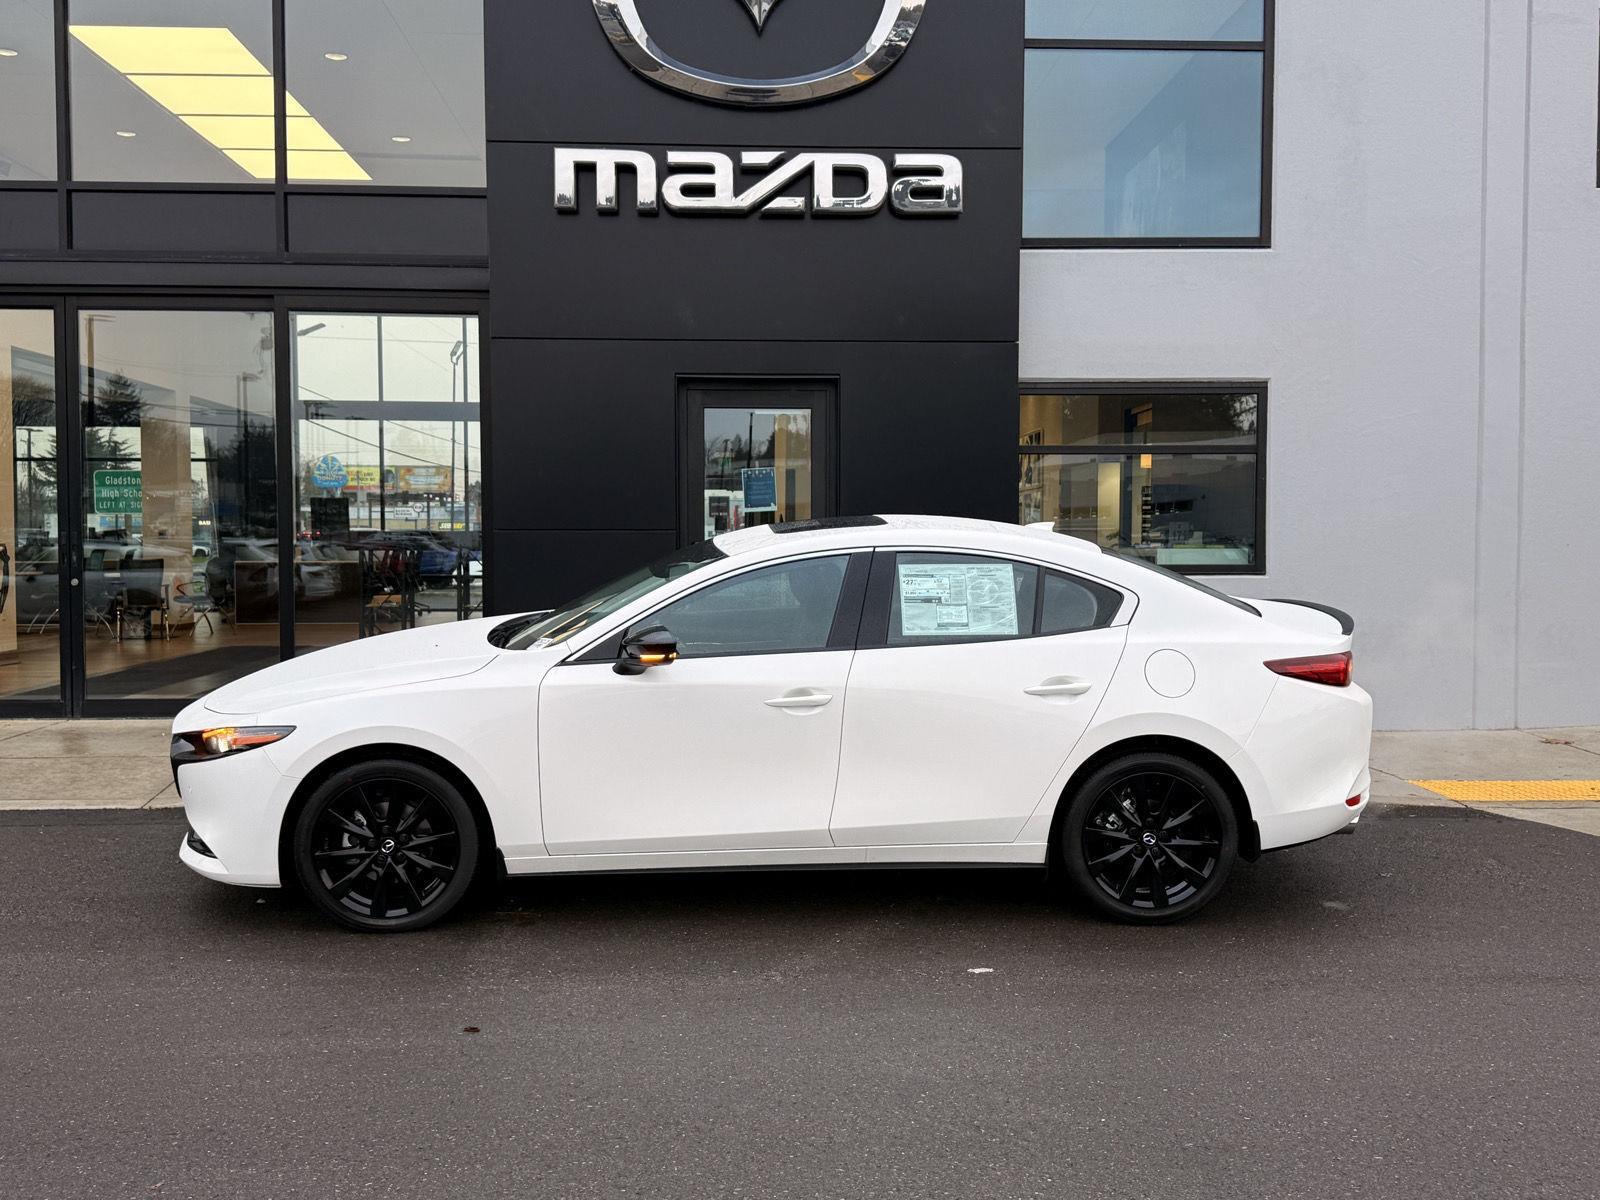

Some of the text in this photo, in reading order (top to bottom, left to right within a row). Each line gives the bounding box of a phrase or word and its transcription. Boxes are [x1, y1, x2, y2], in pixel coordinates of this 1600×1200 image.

[554, 147, 964, 217] mazda
[105, 476, 142, 485] Gladston
[101, 488, 143, 499] High Scho
[99, 501, 115, 509] LEFT
[130, 501, 143, 509] SIG
